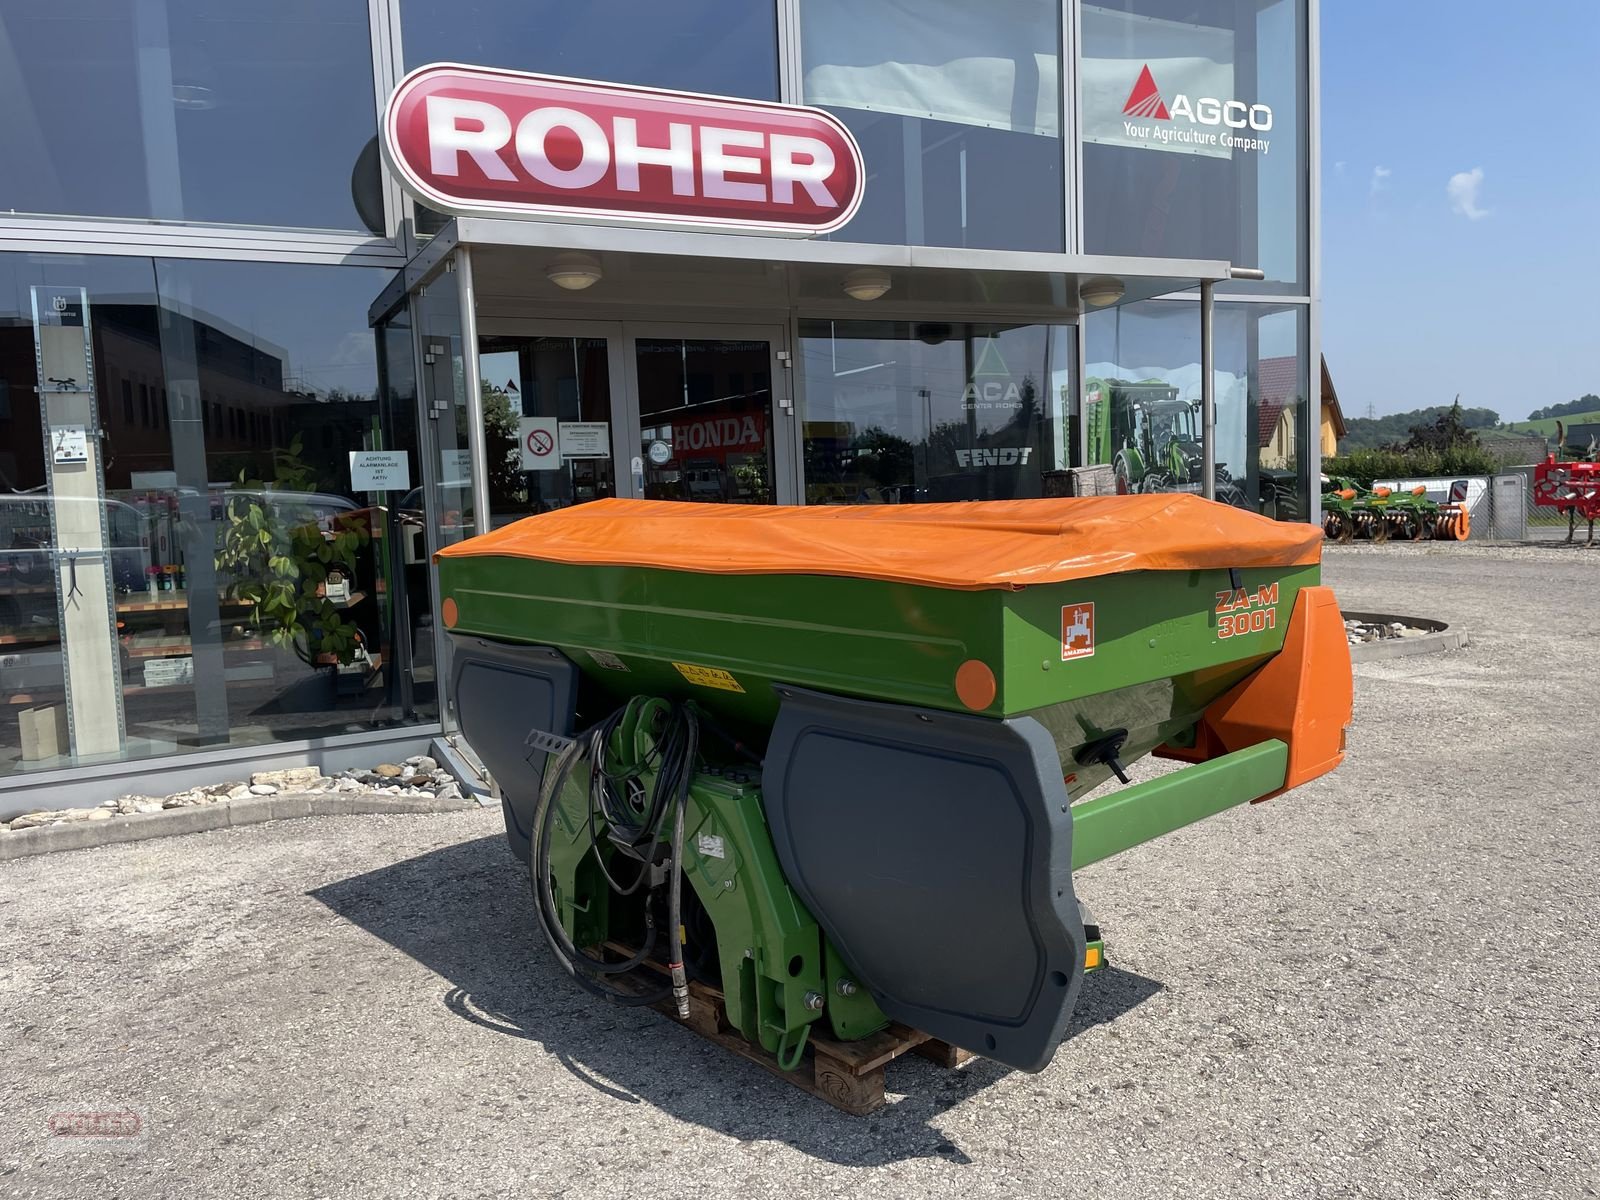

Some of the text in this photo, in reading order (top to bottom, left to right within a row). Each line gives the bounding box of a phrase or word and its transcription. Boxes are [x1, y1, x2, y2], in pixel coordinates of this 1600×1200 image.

[1170, 94, 1273, 131] AGCO
[426, 96, 839, 208] ROHER
[1123, 121, 1270, 154] Your Agriculture Company
[960, 382, 1023, 402] ACA
[961, 402, 992, 410] CENTER
[673, 416, 760, 450] HONDA
[955, 447, 1033, 468] FENDT
[1215, 582, 1279, 614] ZA-M
[1217, 607, 1276, 639] 3001
[1063, 647, 1093, 657] AMAZONE
